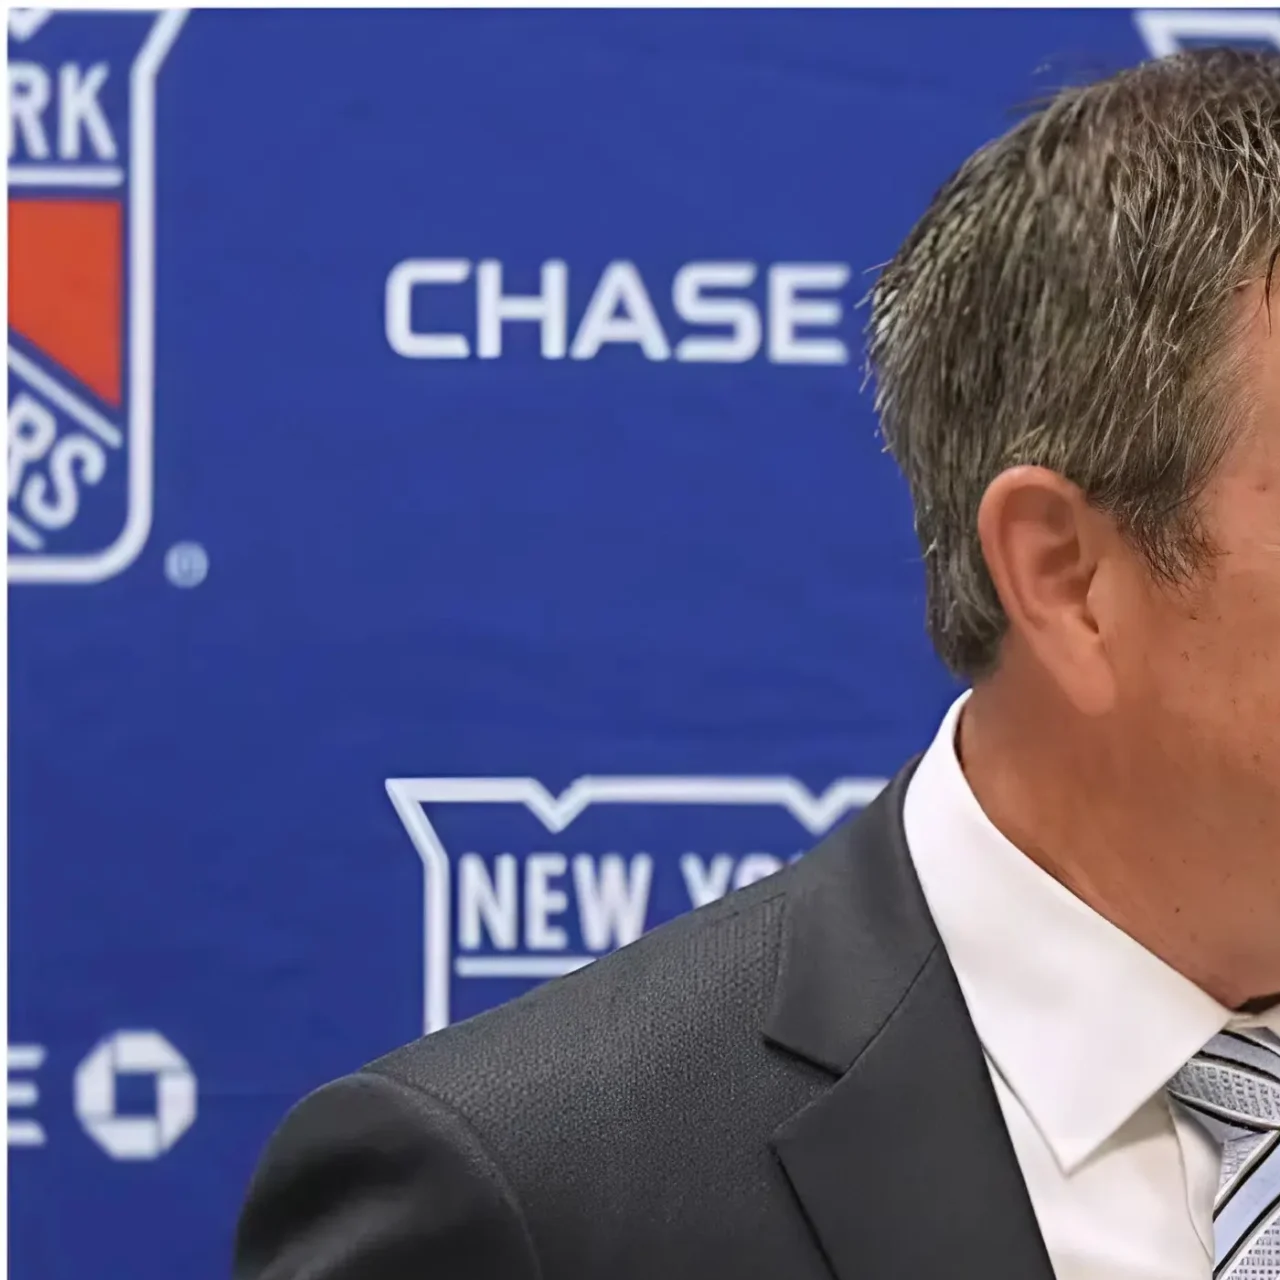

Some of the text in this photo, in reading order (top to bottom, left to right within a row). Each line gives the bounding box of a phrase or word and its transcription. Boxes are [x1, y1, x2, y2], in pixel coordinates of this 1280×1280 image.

[8, 61, 118, 160] RK
[385, 259, 851, 364] CHASE
[458, 852, 654, 951] NEW
